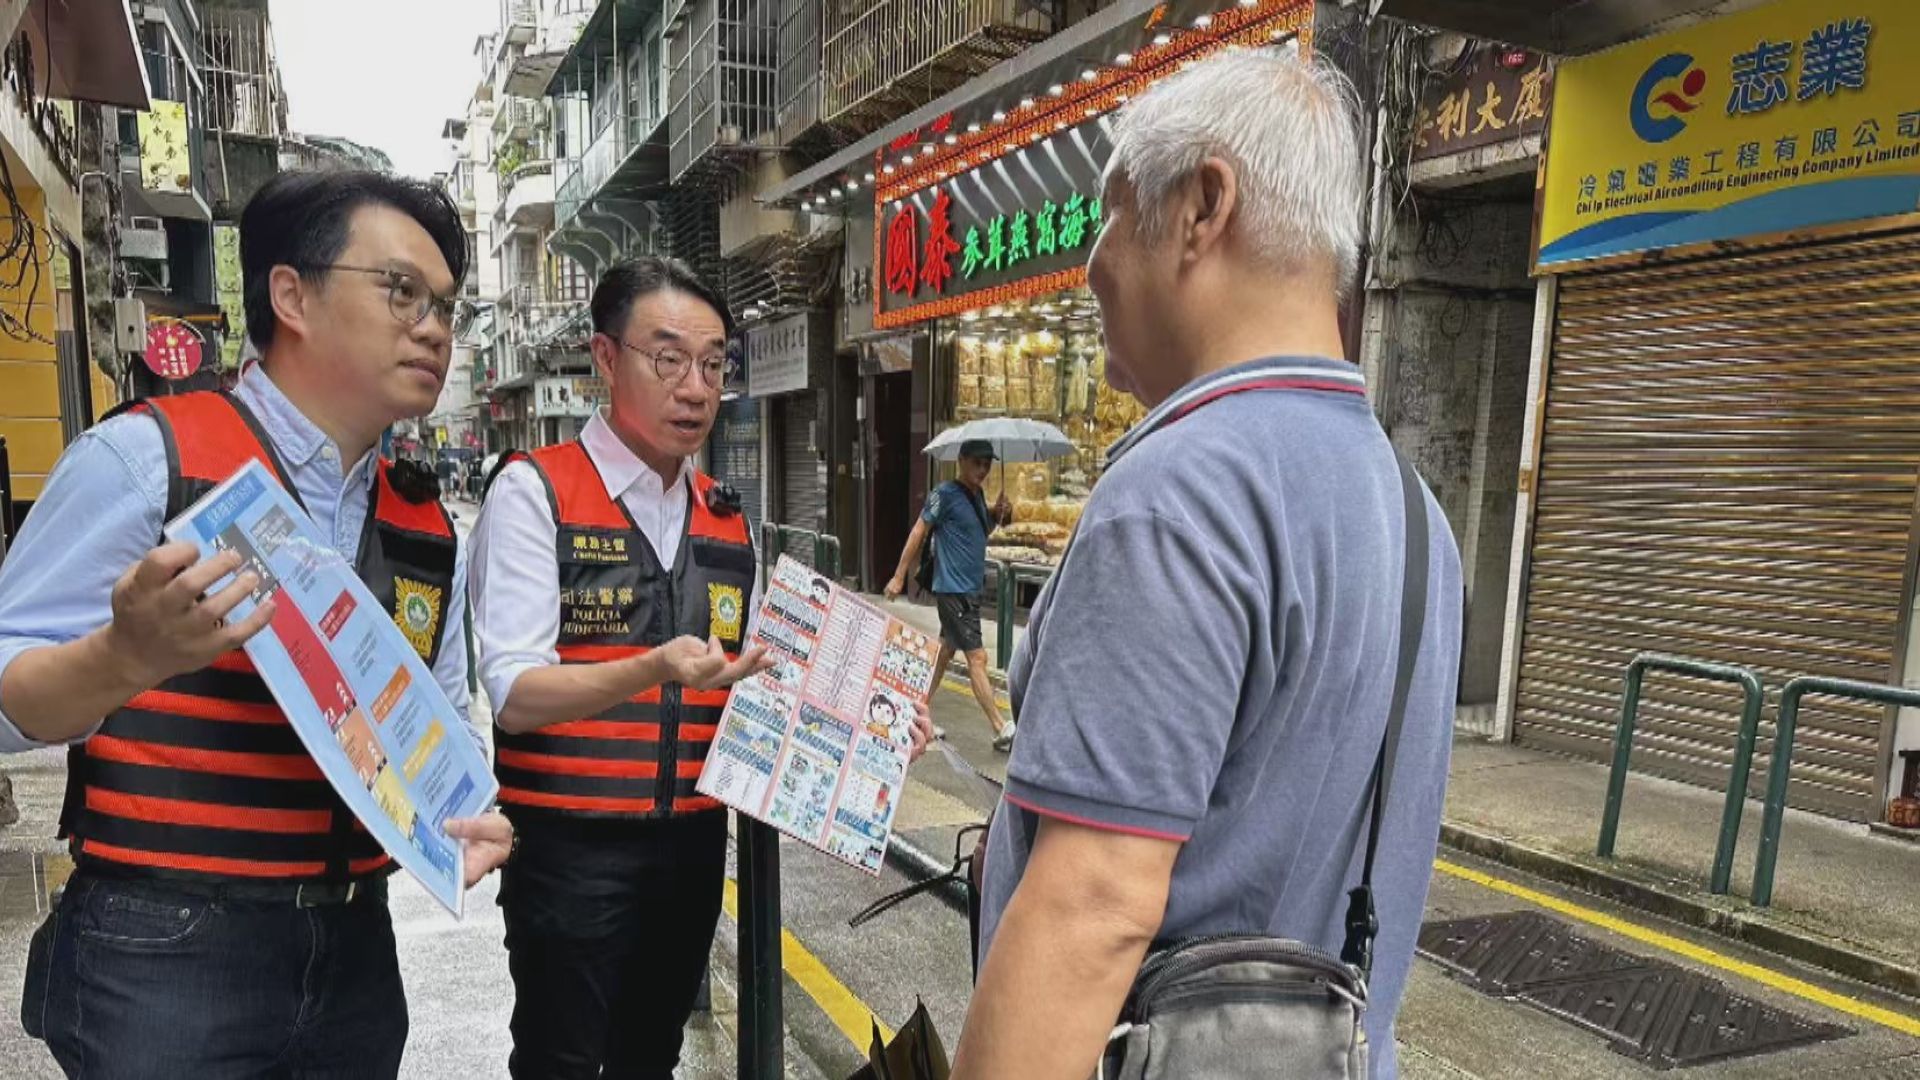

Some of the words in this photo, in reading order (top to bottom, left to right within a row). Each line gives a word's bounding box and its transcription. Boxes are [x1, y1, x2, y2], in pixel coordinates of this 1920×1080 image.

[1727, 17, 1872, 114] 志業
[1576, 200, 1591, 215] Chi
[1605, 190, 1653, 209] Electrical
[1726, 165, 1800, 188] Engineering
[1802, 154, 1863, 174] Company
[1865, 142, 1920, 163] Limited
[1578, 110, 1920, 200] 冷氣電業工程有限公司
[885, 189, 961, 298] 國泰
[560, 587, 634, 606] 司法警察
